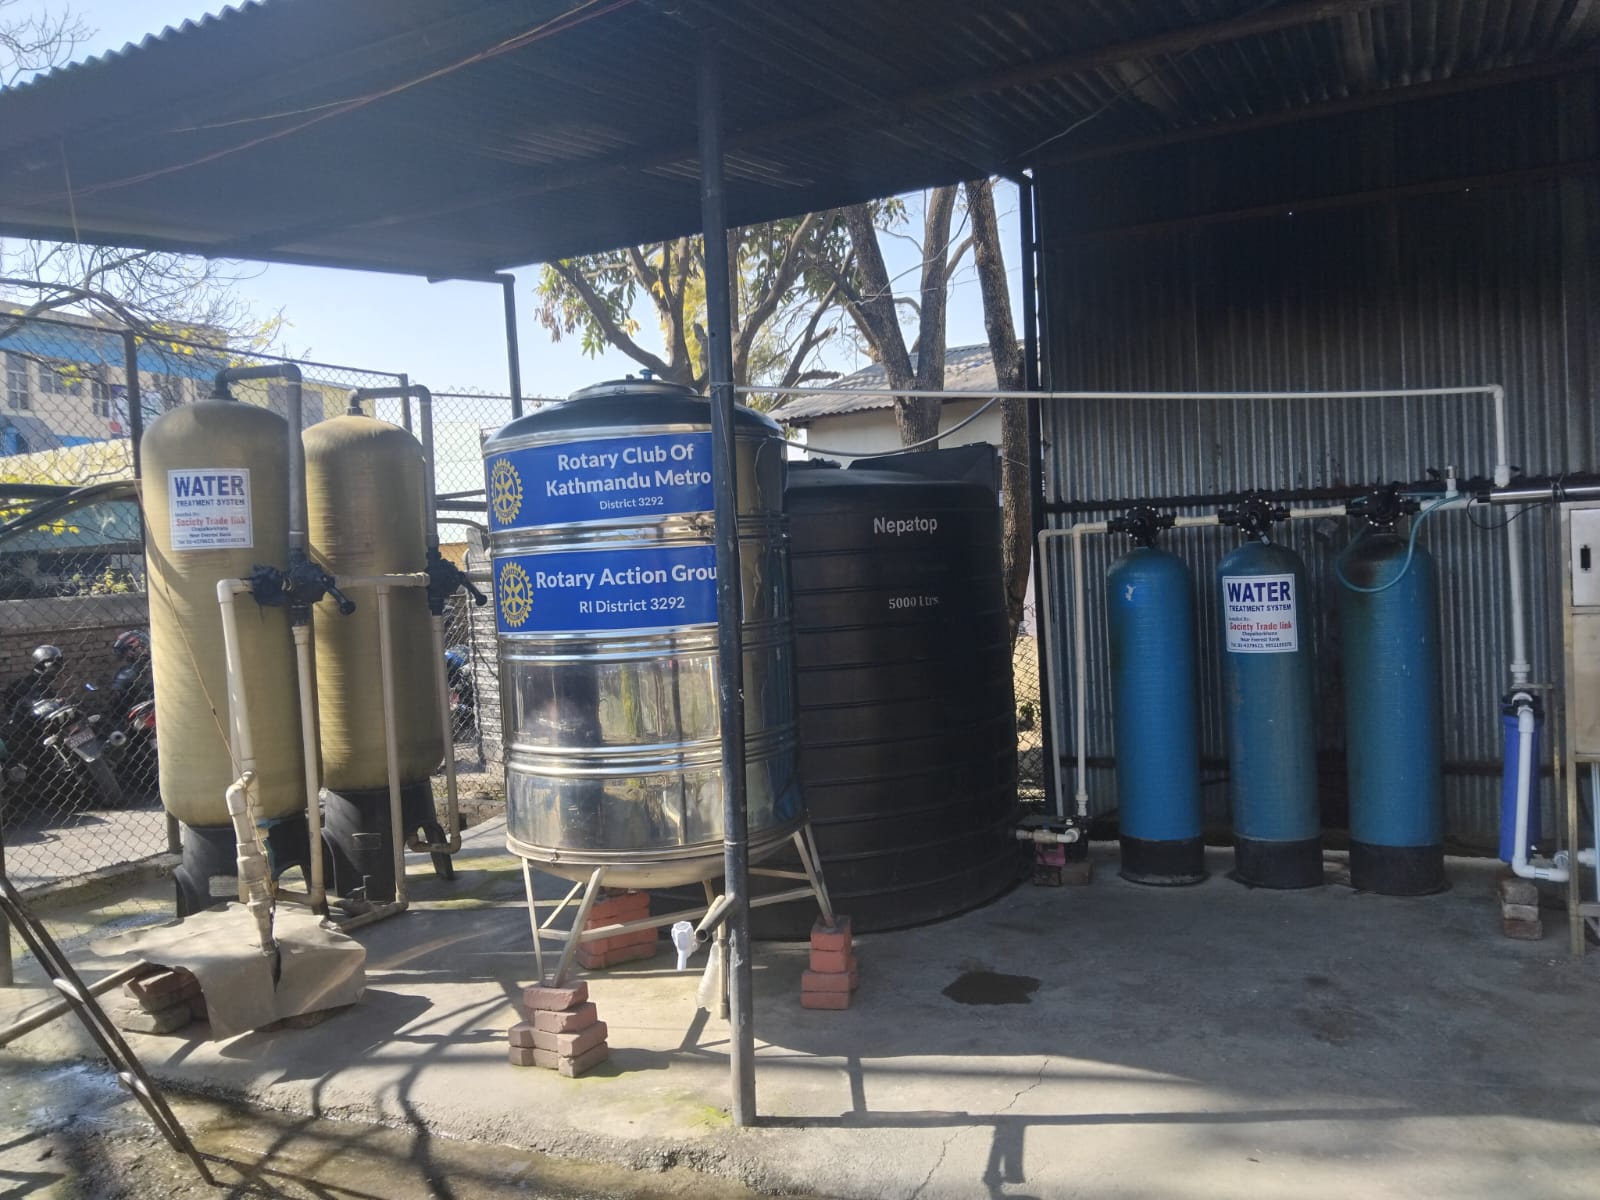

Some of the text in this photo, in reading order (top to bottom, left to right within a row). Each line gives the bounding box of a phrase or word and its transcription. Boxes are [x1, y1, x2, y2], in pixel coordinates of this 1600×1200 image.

[558, 443, 694, 471] Rotary Club Of
[174, 475, 245, 497] WATER
[546, 469, 712, 497] Kathmandu Metro
[176, 498, 245, 507] TREATMENT SYSTEM
[599, 496, 664, 510] District 3292
[206, 517, 229, 525] Trade
[873, 516, 938, 536] Nepatop
[535, 571, 595, 590] Rotary
[599, 566, 668, 586] Action
[671, 564, 717, 582] Grou
[1227, 581, 1291, 602] WATER
[579, 596, 686, 613] RI District 3292
[888, 597, 917, 609] 5000
[1266, 603, 1292, 611] SYSTEM
[1229, 621, 1292, 631] Society Trade link
